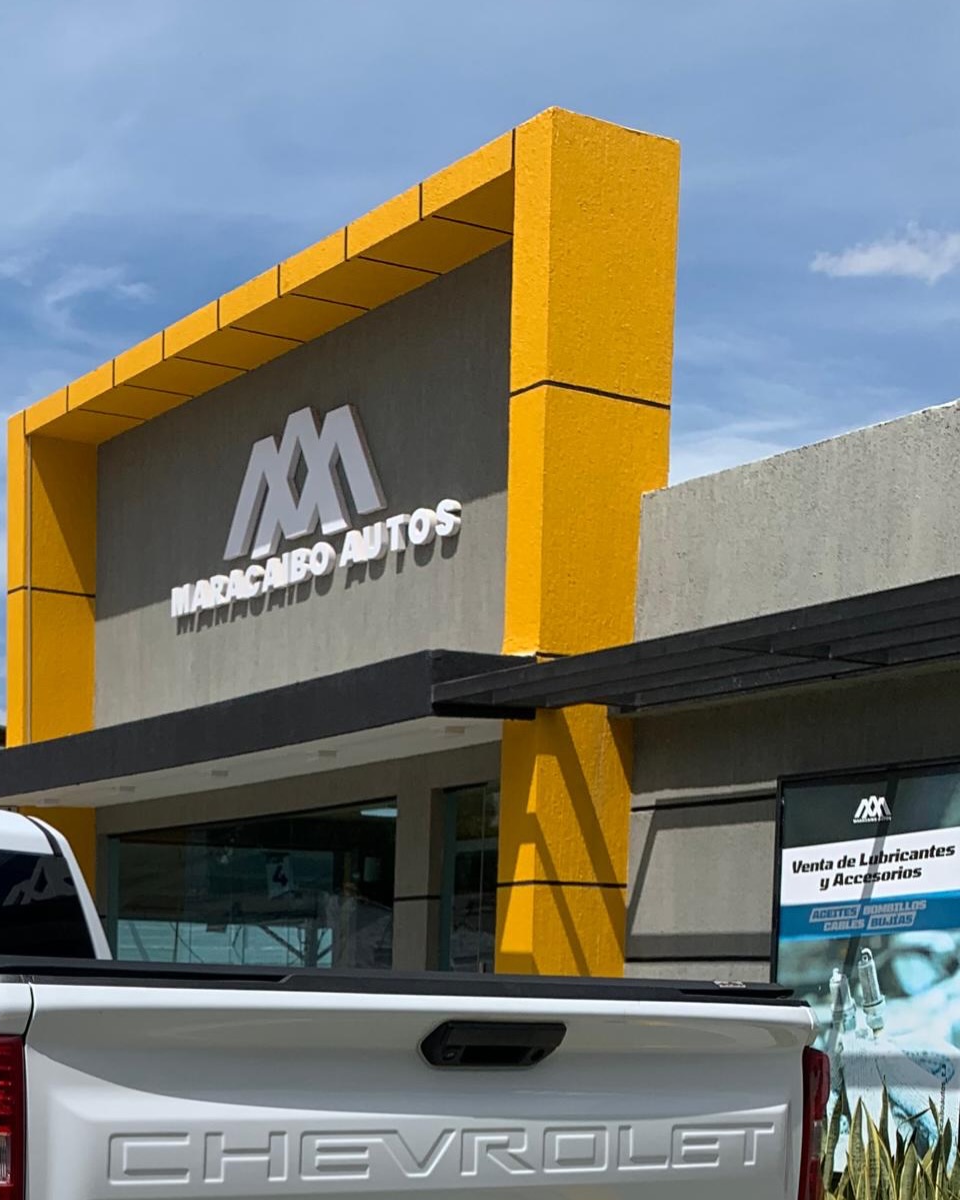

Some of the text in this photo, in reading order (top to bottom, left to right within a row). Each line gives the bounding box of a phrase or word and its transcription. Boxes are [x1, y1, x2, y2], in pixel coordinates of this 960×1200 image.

[171, 499, 462, 618] MARACAIBO AUTOS
[792, 845, 956, 874] Venta de Lubricantes
[819, 866, 922, 891] y Accesorios
[107, 1122, 775, 1186] CHEVROLET
